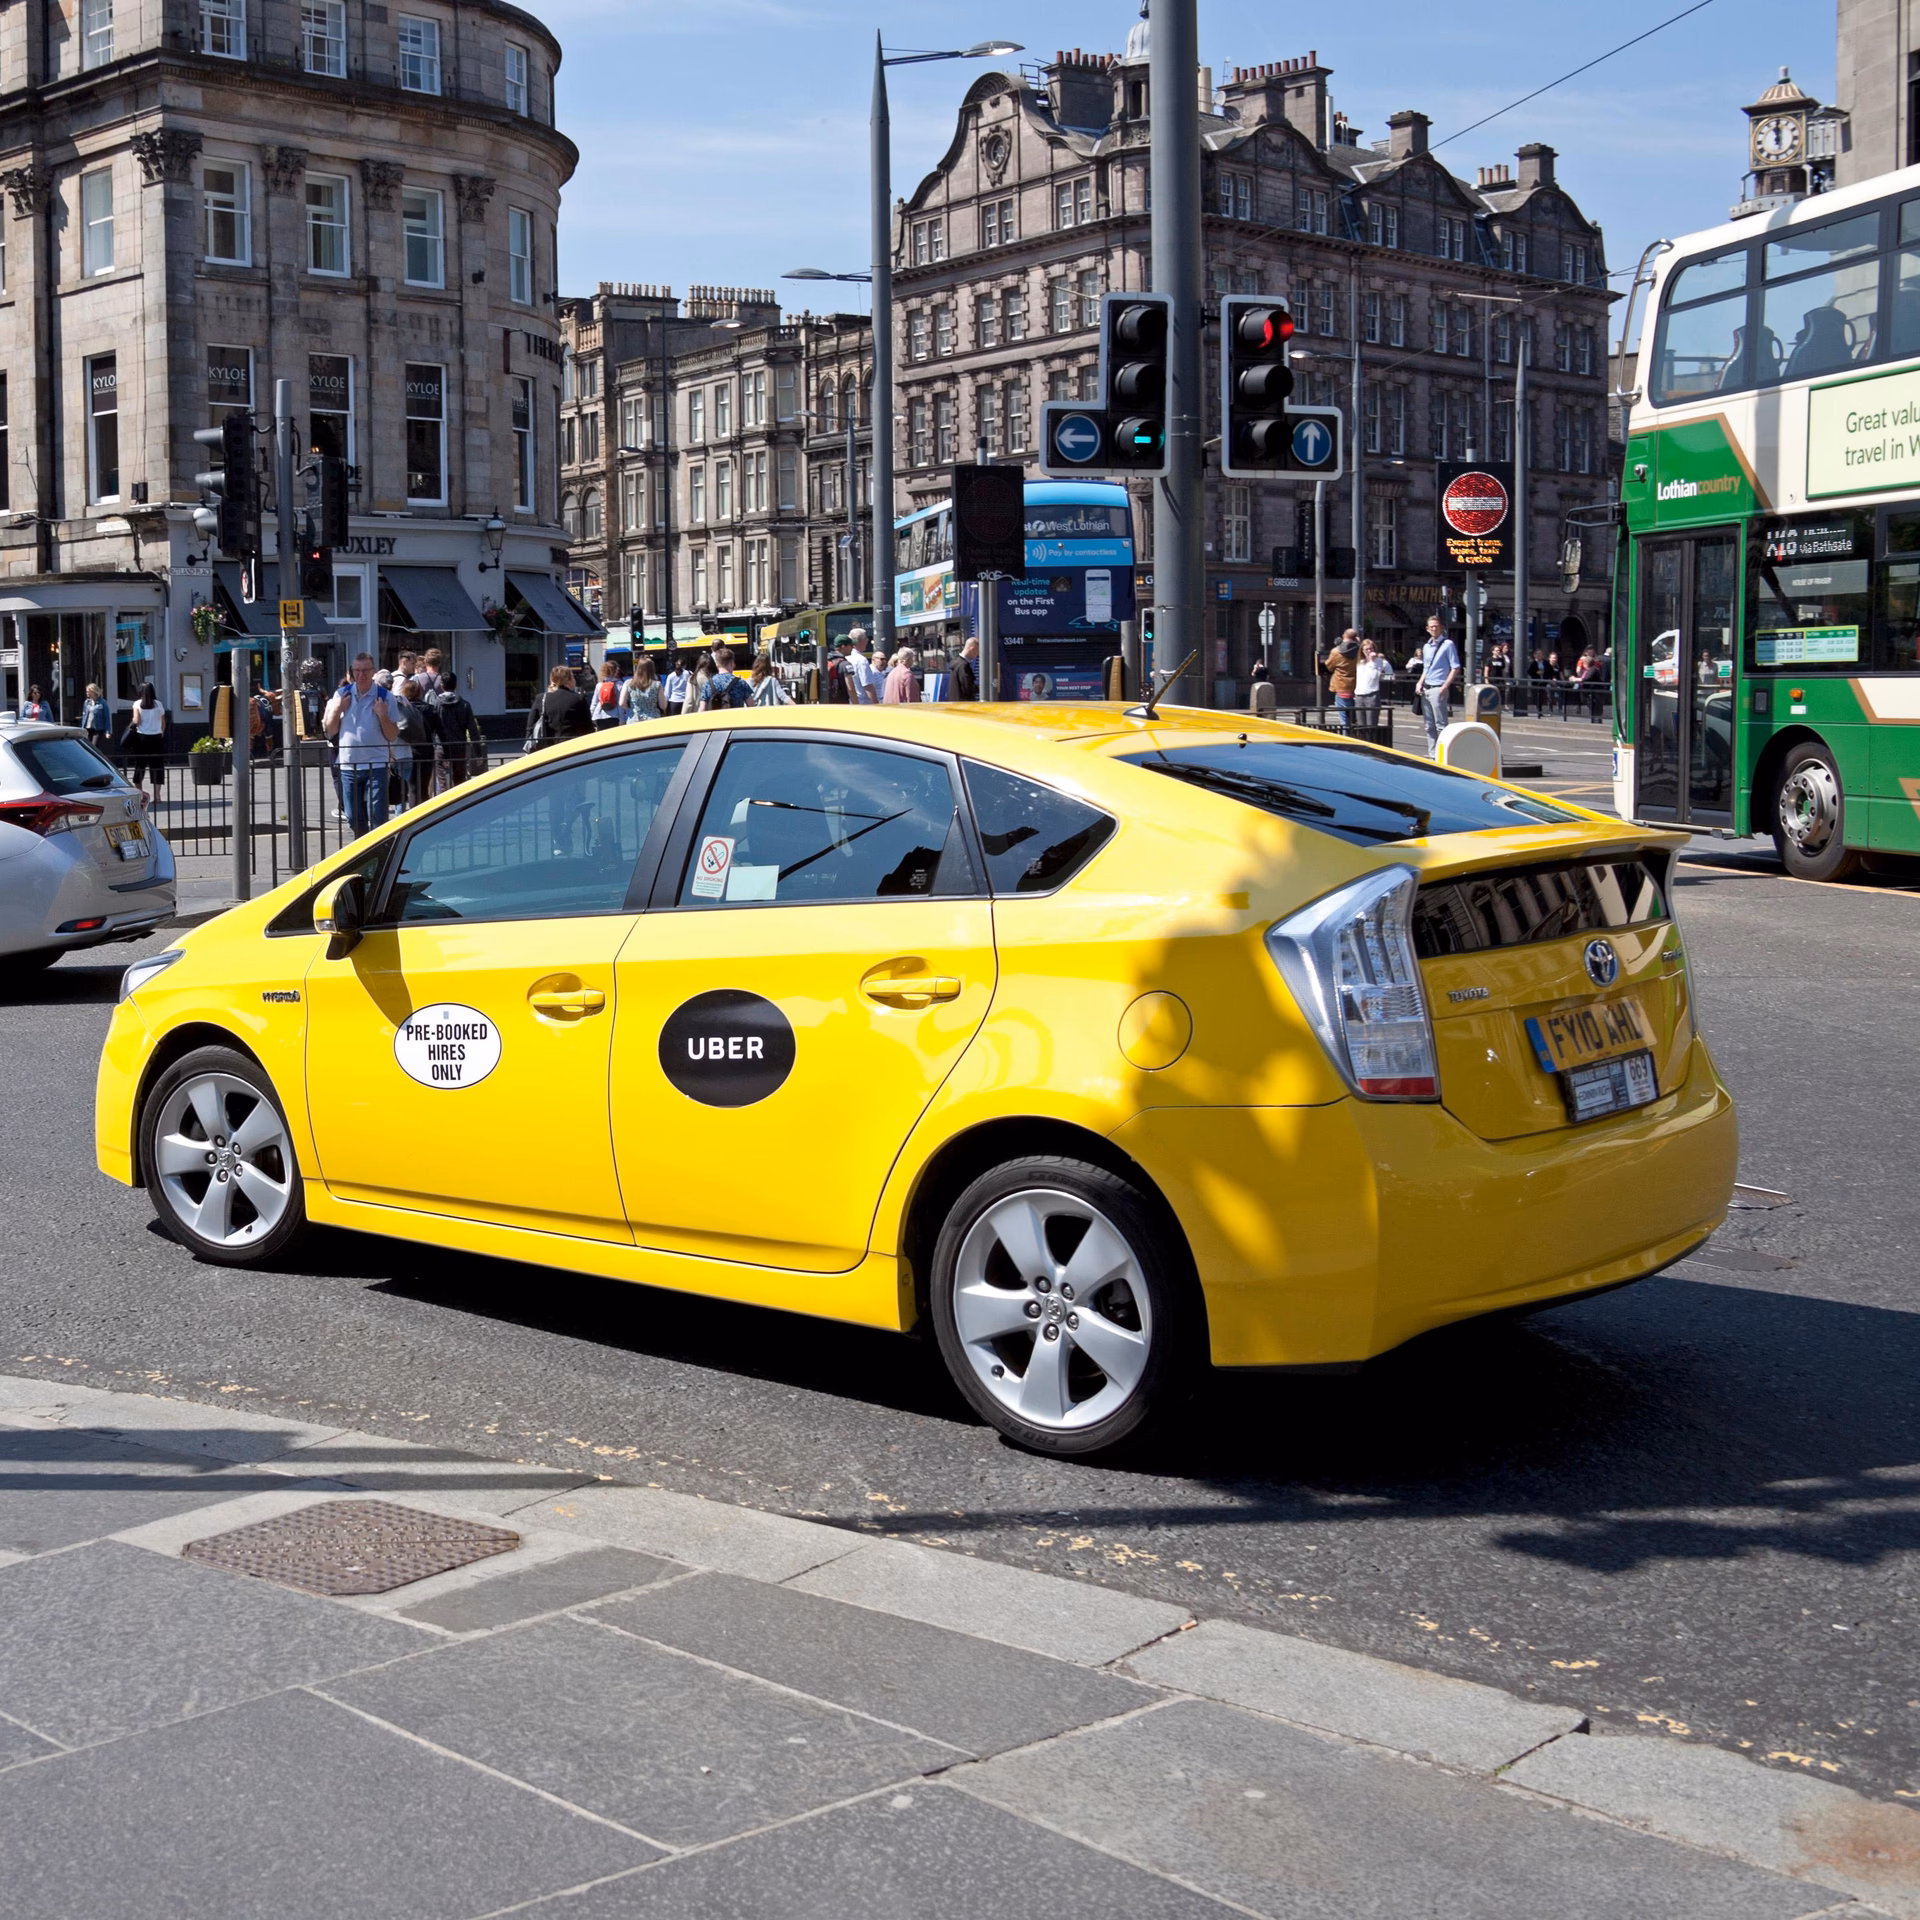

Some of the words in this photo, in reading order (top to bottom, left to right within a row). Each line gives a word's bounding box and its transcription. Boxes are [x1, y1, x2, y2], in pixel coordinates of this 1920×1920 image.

[208, 366, 247, 380] KYLOE
[93, 374, 116, 389] KYLO
[309, 375, 345, 389] KYLOE
[406, 382, 440, 395] KYLOE
[512, 396, 528, 408] YLOE
[1846, 408, 1887, 433] Great
[1892, 401, 1920, 426] valu
[1845, 438, 1886, 466] travel
[1891, 437, 1904, 460] in
[1046, 521, 1071, 531] West
[1073, 521, 1110, 531] Lothian
[1048, 548, 1062, 557] Pay
[1075, 548, 1117, 556] contactless
[1273, 578, 1299, 587] GREGGS
[1014, 588, 1048, 596] updates
[1019, 597, 1034, 605] the
[1035, 597, 1055, 605] First
[1014, 607, 1030, 615] Bus
[1031, 608, 1048, 616] app
[1004, 637, 1024, 645] 33441
[1447, 987, 1489, 1003] TOYOTA
[406, 1022, 488, 1042] PRE-BOOKED
[1548, 1010, 1604, 1059] FY10
[428, 1044, 466, 1061] HIRES
[687, 1036, 765, 1060] UBER
[431, 1064, 463, 1081] ONLY
[1629, 1056, 1648, 1081] 669
